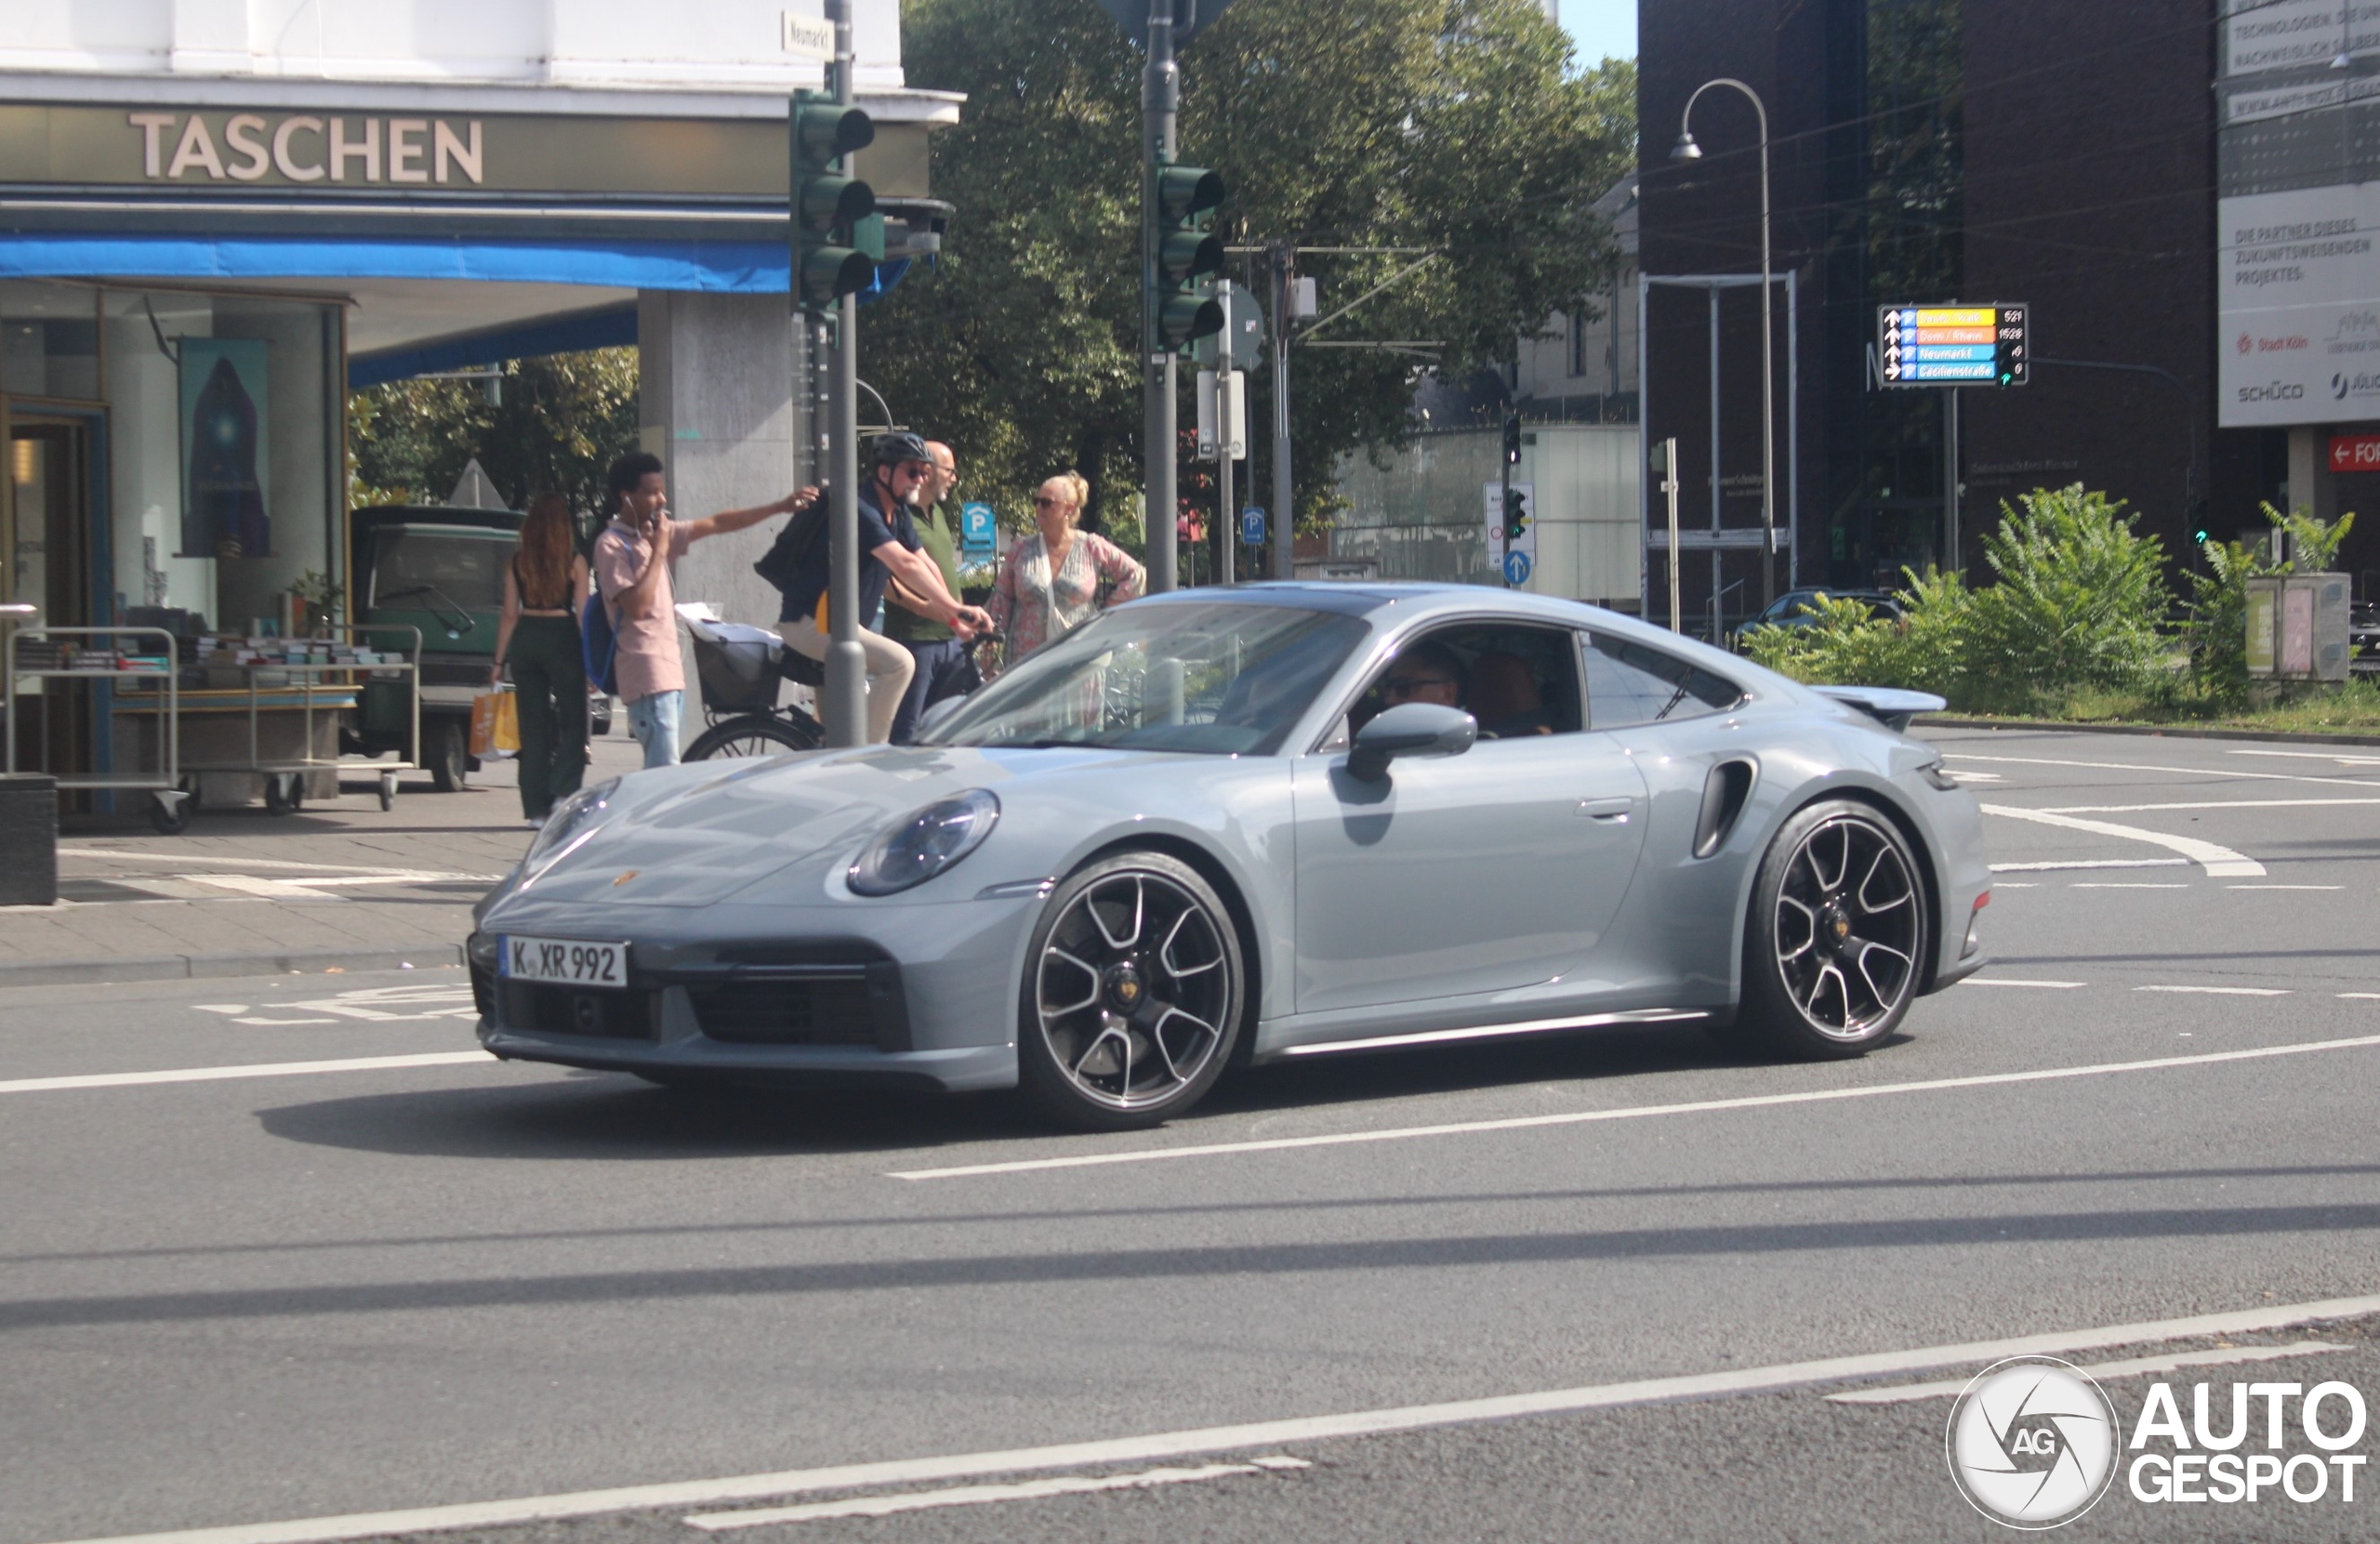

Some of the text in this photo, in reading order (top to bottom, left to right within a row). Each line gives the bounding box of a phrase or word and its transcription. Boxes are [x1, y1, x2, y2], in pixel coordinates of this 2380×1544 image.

[790, 20, 827, 50] Neumarkt
[128, 112, 483, 184] TASCHEN
[2235, 218, 2356, 244] DIE PARTNER DIESES
[2235, 239, 2371, 265] ZUKUNFTSWEISENDEN
[2004, 310, 2022, 323] 521
[1920, 347, 1973, 359] Neumarkt
[2257, 334, 2308, 352] Stadt Köln
[1919, 364, 1992, 376] Cäcilienstraße
[2238, 380, 2304, 402] SCHÜCO
[972, 515, 987, 534] P
[1250, 517, 1259, 530] P
[513, 941, 616, 982] K XR 992
